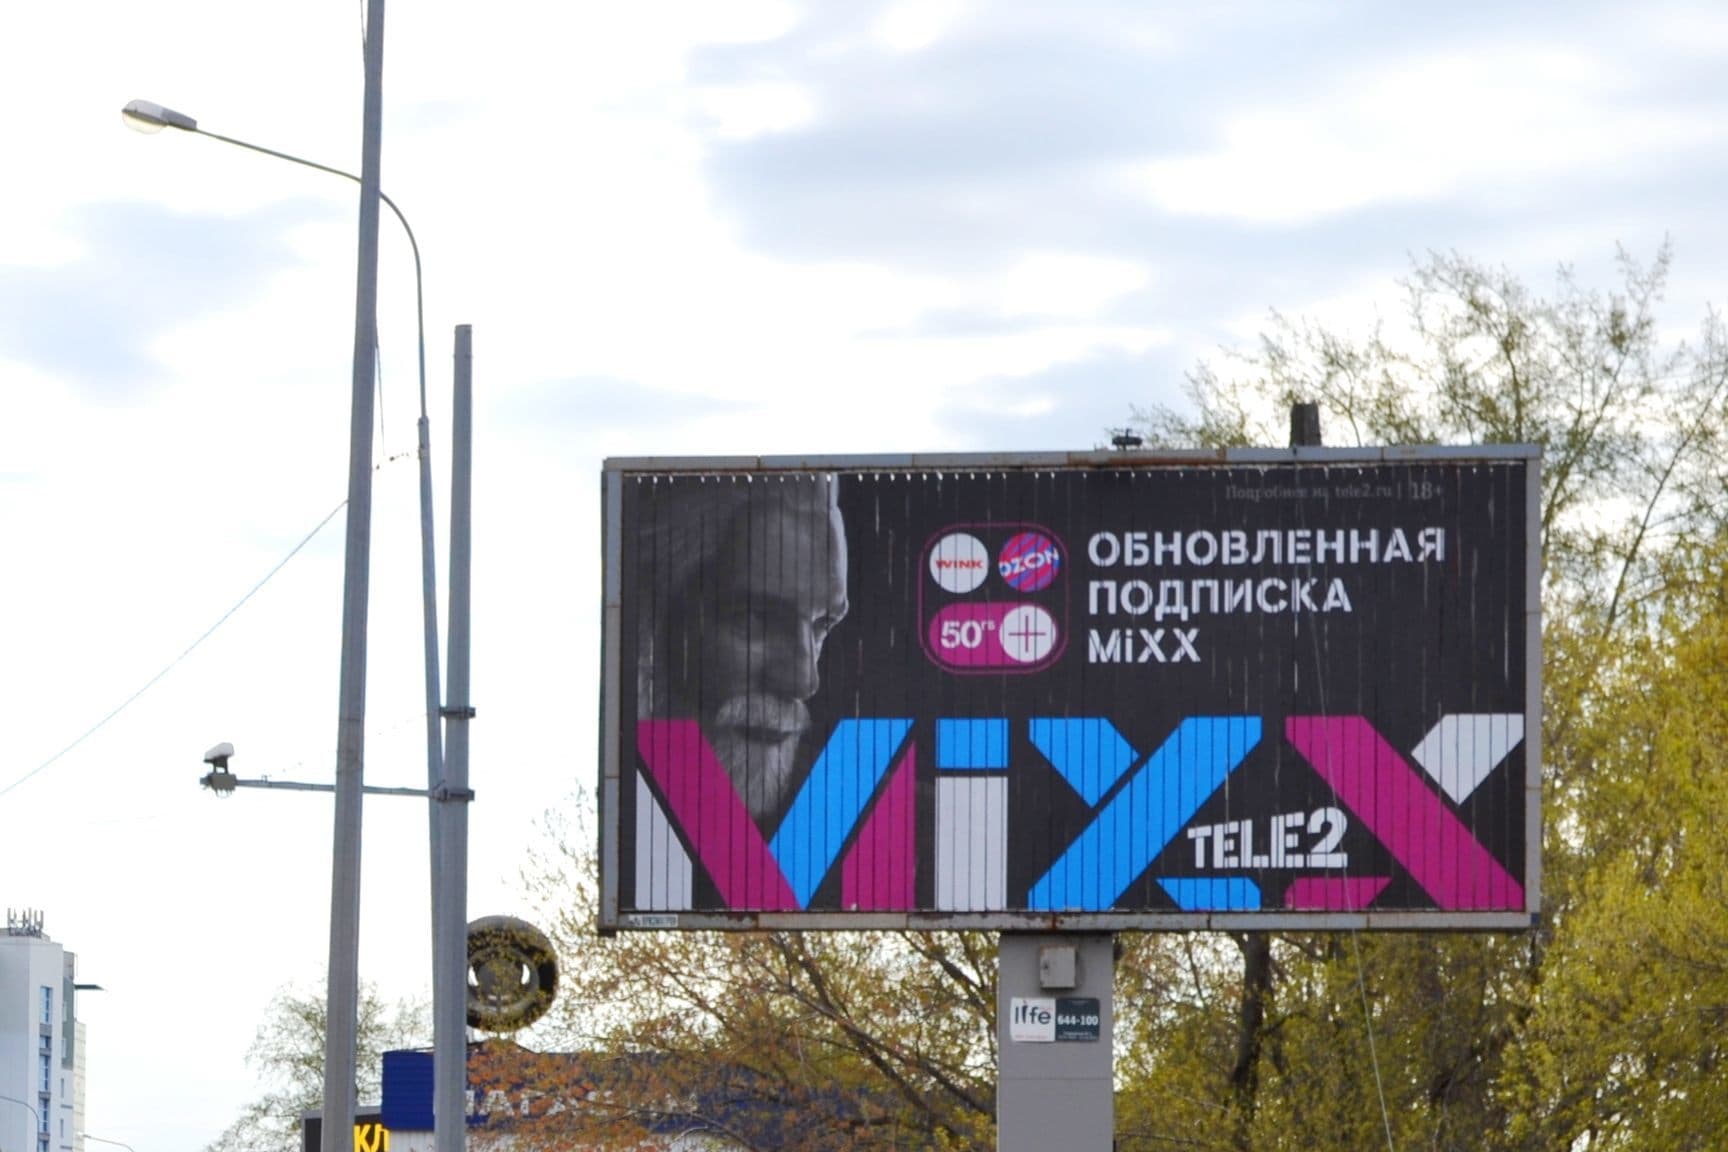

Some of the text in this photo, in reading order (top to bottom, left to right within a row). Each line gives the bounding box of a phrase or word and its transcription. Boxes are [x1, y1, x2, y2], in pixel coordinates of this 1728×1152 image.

[1411, 481, 1443, 500] 18+
[1087, 527, 1447, 567] ОБНОВЛЕННАЯ
[1088, 577, 1353, 622] ПОДПИСКА
[940, 620, 983, 649] 50
[1187, 806, 1349, 870] TELE2
[1057, 1015, 1100, 1027] 644-100
